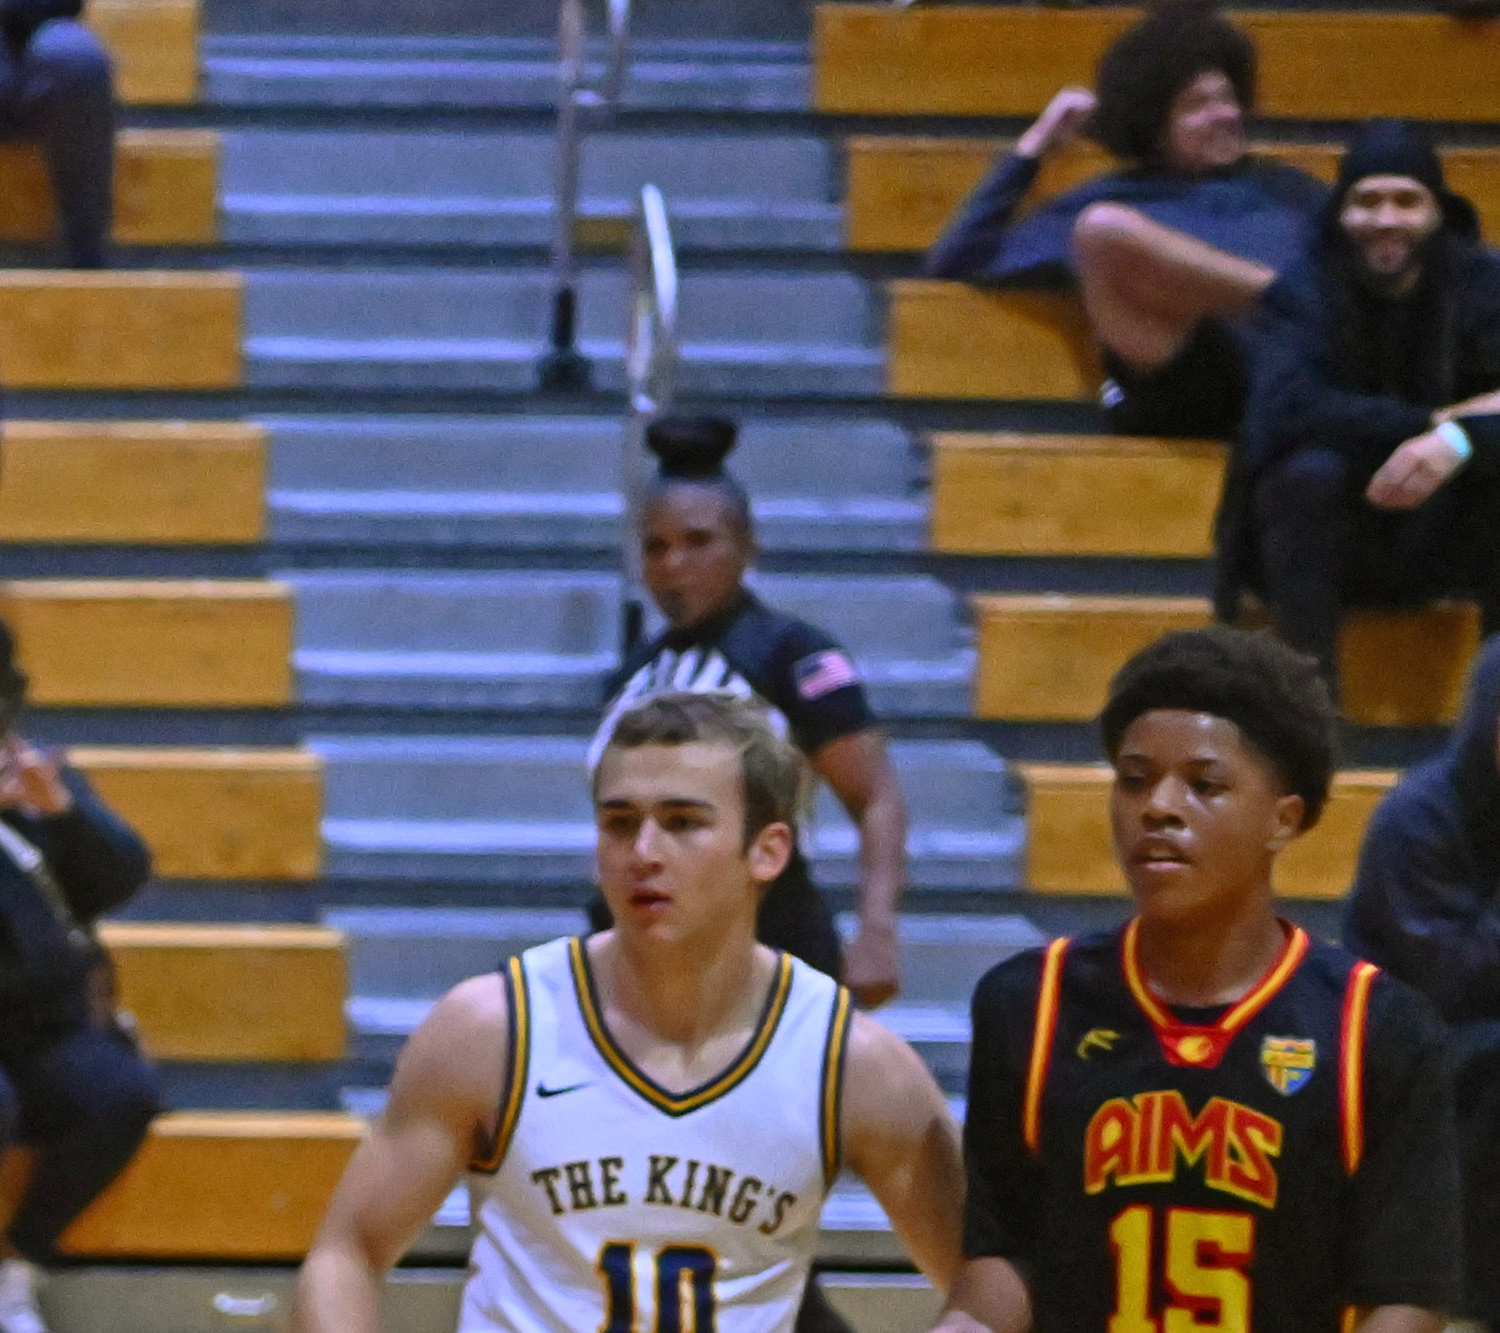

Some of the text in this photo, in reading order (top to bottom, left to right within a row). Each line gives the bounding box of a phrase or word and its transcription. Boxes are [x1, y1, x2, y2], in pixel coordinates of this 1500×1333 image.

[531, 1155, 798, 1236] THE KING'S
[1085, 1090, 1284, 1210] AIMS
